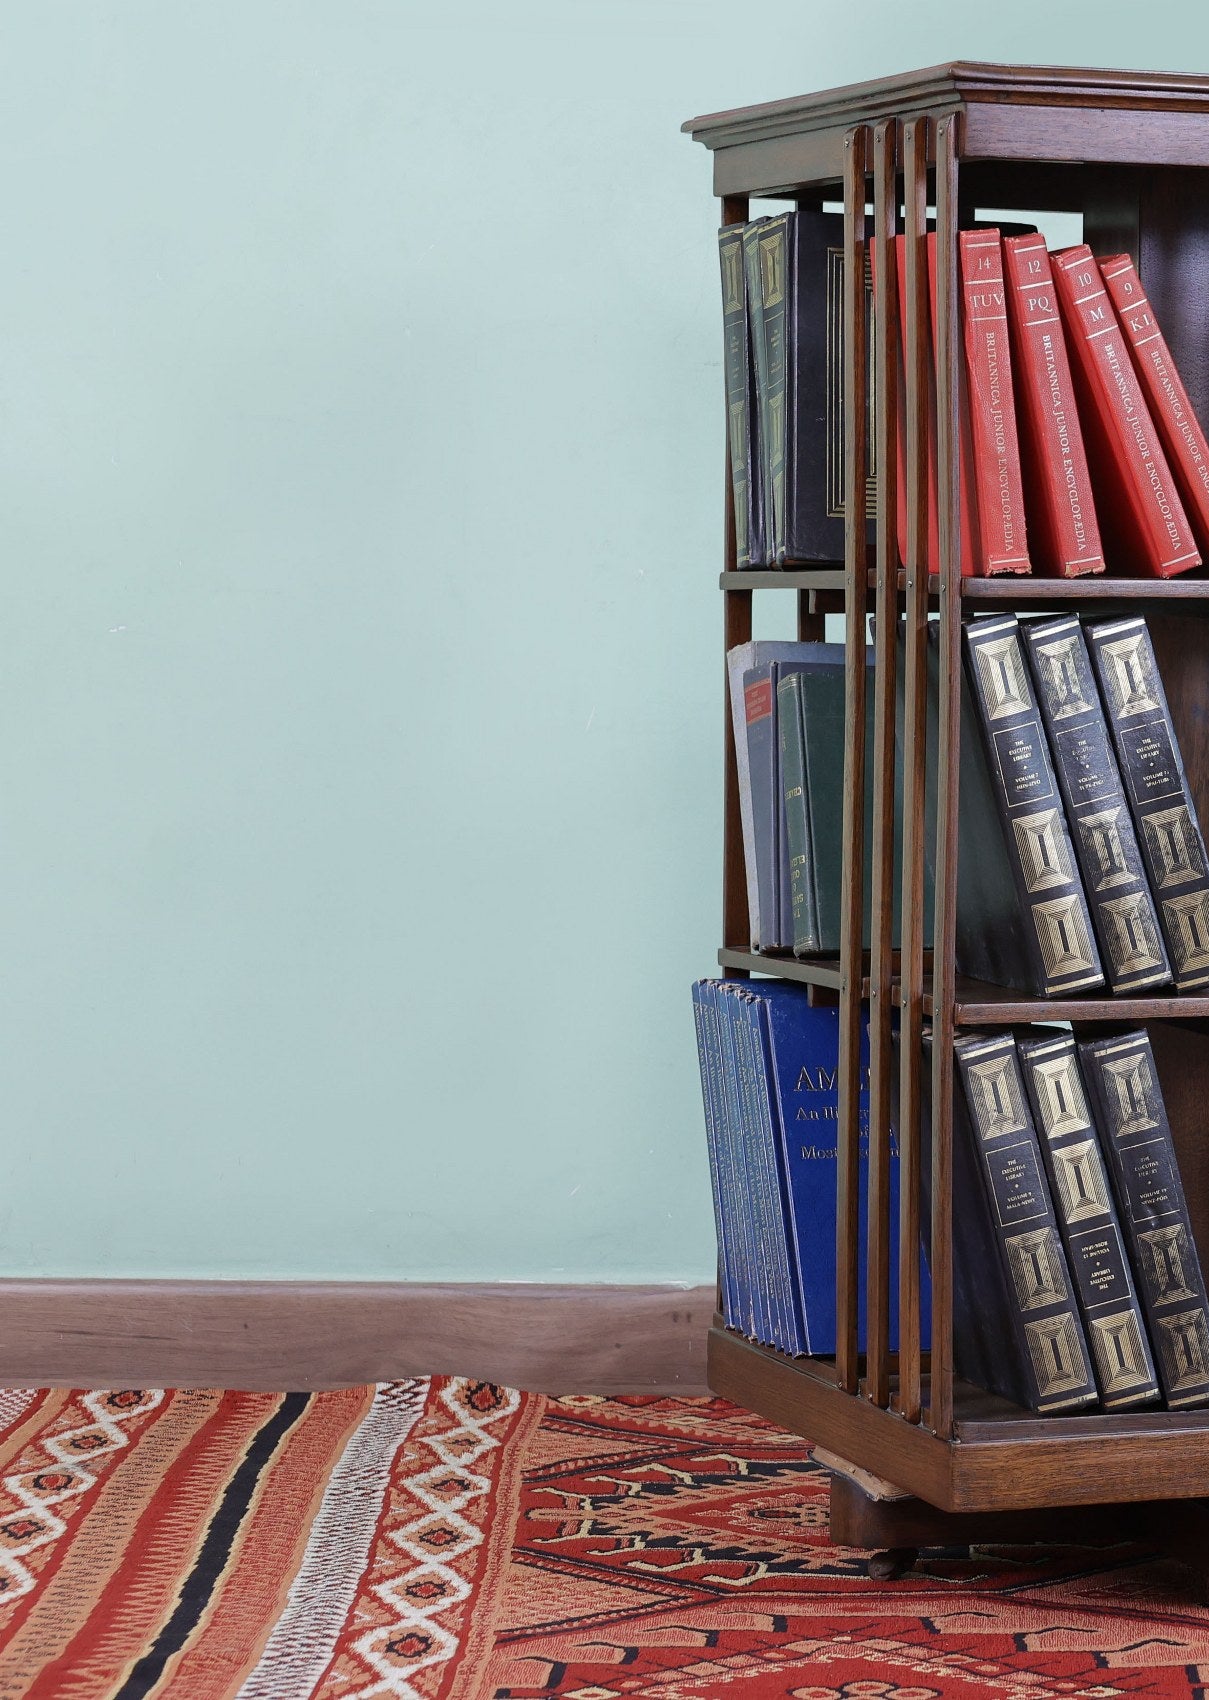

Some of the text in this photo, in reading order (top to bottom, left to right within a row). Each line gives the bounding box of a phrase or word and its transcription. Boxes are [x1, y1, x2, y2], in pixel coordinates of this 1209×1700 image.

[977, 257, 991, 270] 14
[1028, 260, 1042, 274] 12
[1078, 272, 1092, 287] 10
[1124, 283, 1133, 295] 9
[970, 293, 1004, 308] TUV
[1029, 296, 1053, 312] PQ
[1090, 306, 1105, 322] M
[985, 332, 1003, 405] BRITANNICA
[1042, 335, 1061, 408] BRITANNICA
[1053, 409, 1070, 454] JUNIOR
[1104, 343, 1133, 414] BRITANNICA
[1127, 414, 1150, 460] JUNIOR
[1150, 350, 1184, 419] BRITANNICA
[1176, 416, 1202, 463] JUNIOR
[991, 407, 1006, 454] JUNIOR
[1008, 744, 1033, 756] EXECUTIVE
[1136, 742, 1161, 754] EXECUTIVE
[1012, 752, 1032, 762] LIBRARY
[1015, 773, 1035, 783] VOLUME
[1142, 772, 1164, 781] VOLUME
[795, 1107, 819, 1120] An
[1001, 1164, 1026, 1175] EXECUTIVE
[1005, 1172, 1025, 1181] LIBRARY
[1007, 1192, 1029, 1202] VOLUME
[1089, 1247, 1110, 1258] VOLUME
[1090, 1268, 1111, 1278] LIBRARY
[1089, 1274, 1115, 1285] EXECUTIVE
